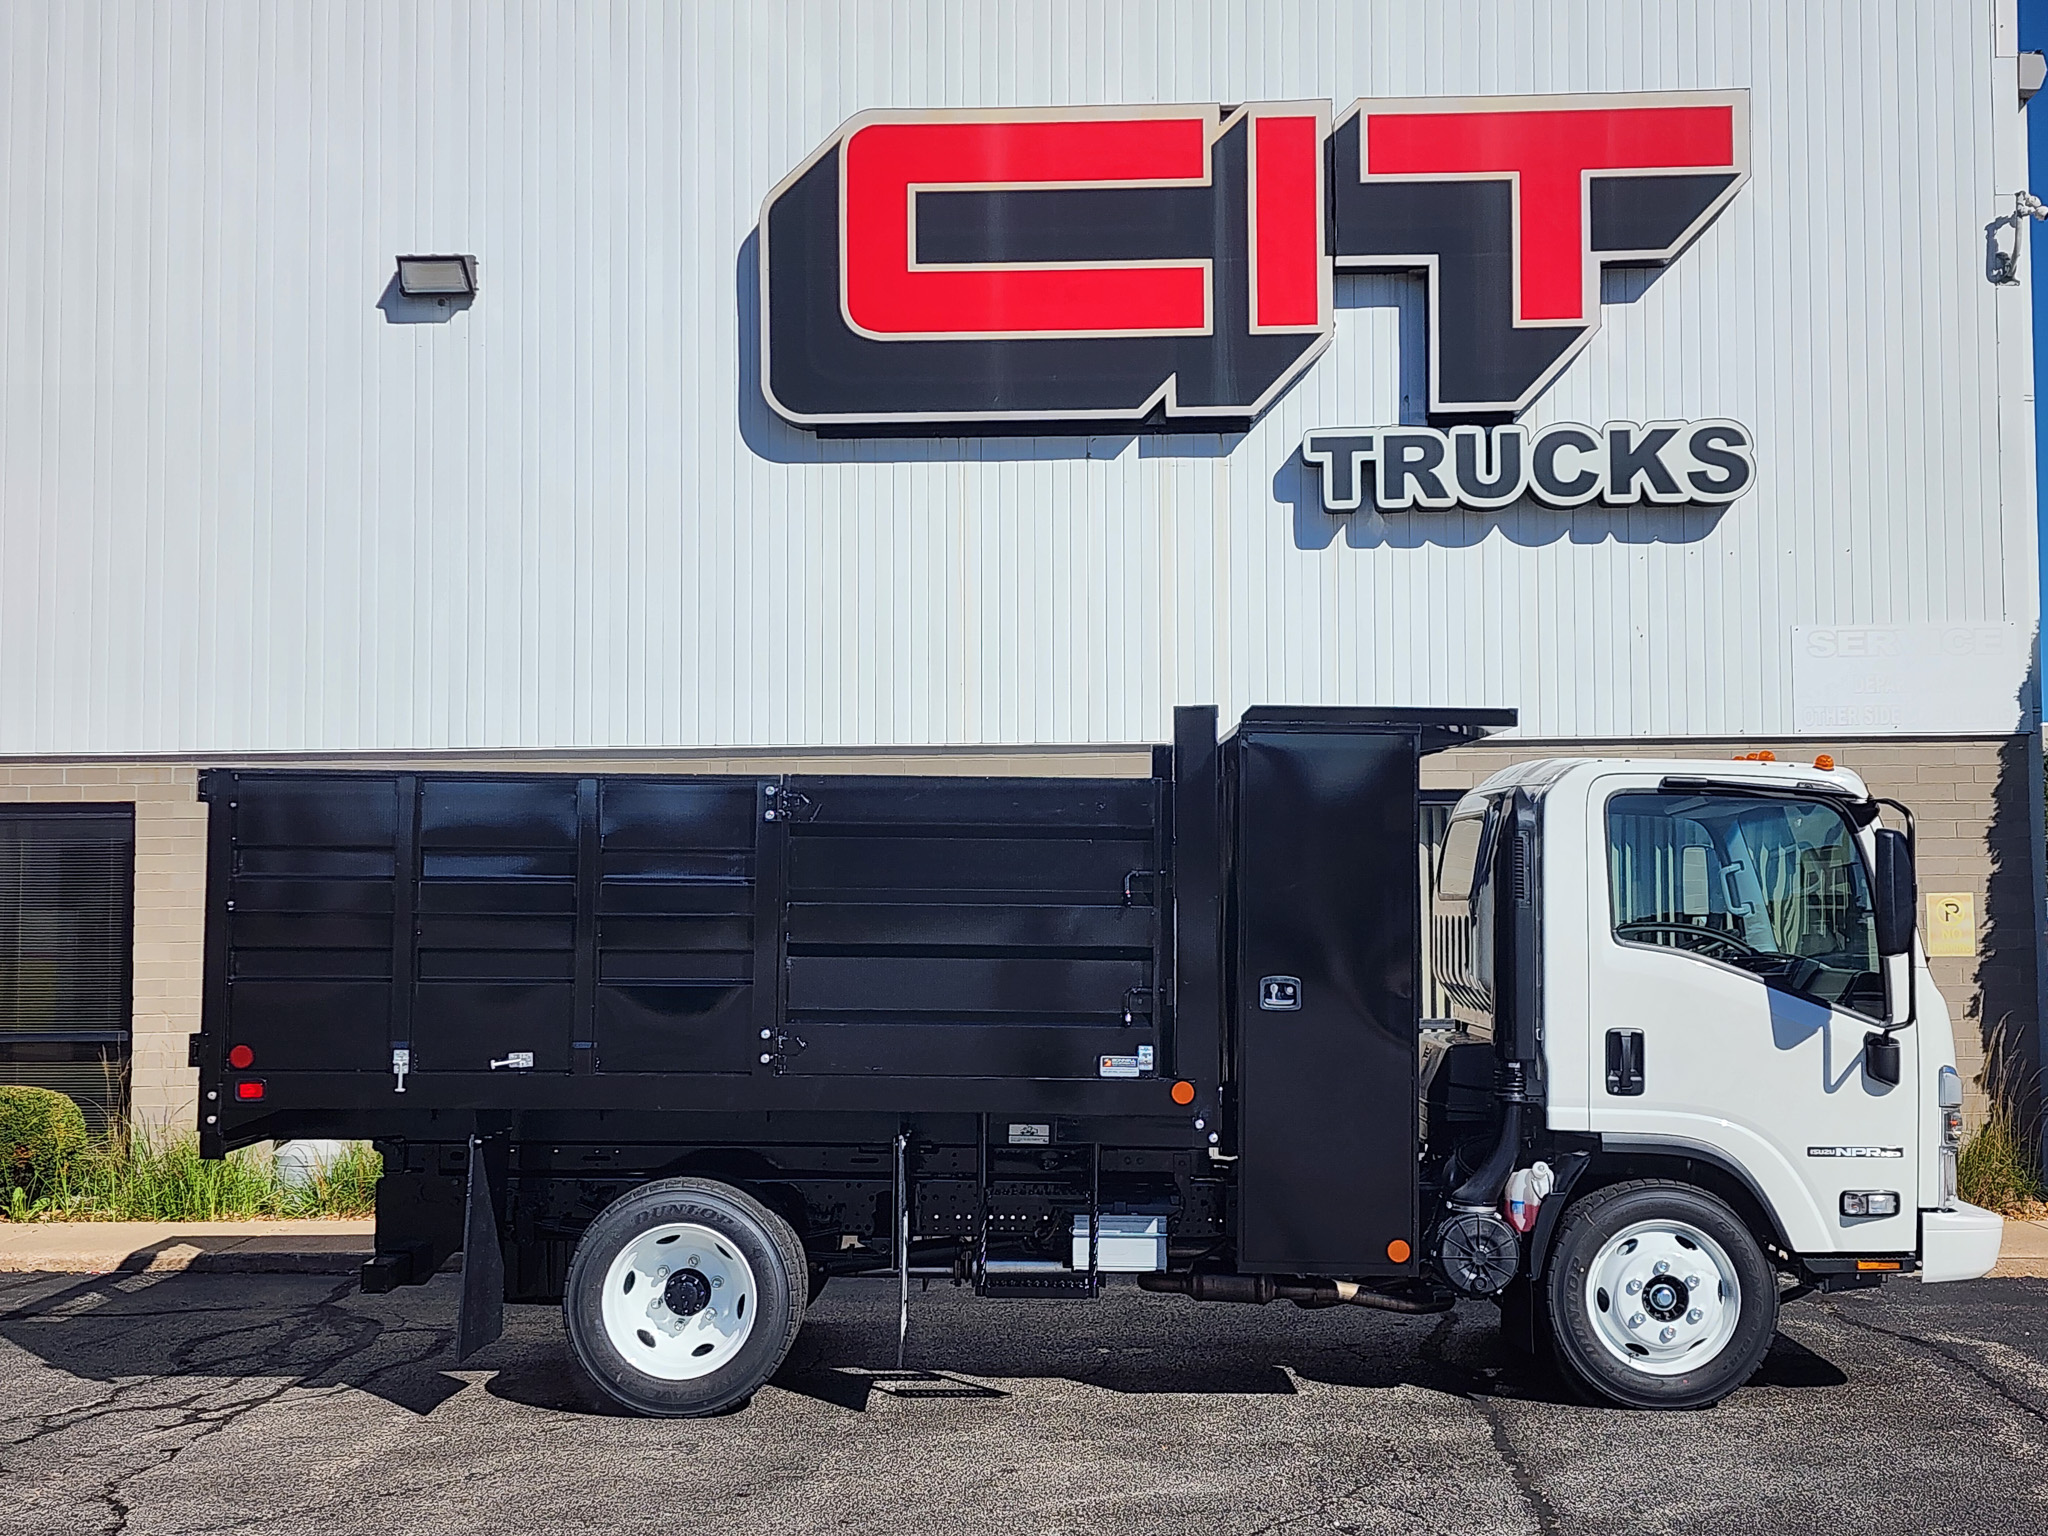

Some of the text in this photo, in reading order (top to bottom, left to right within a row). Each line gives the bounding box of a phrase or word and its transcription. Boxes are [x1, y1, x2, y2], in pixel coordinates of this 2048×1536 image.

[838, 88, 1752, 344] CIT
[1307, 422, 1752, 504] TRUCKS
[1803, 705, 1861, 727] OTHER
[1863, 704, 1903, 726] SIDE
[1941, 928, 1963, 940] NO
[1809, 1148, 1835, 1156] ISUZU
[631, 1203, 735, 1226] DUNLOP
